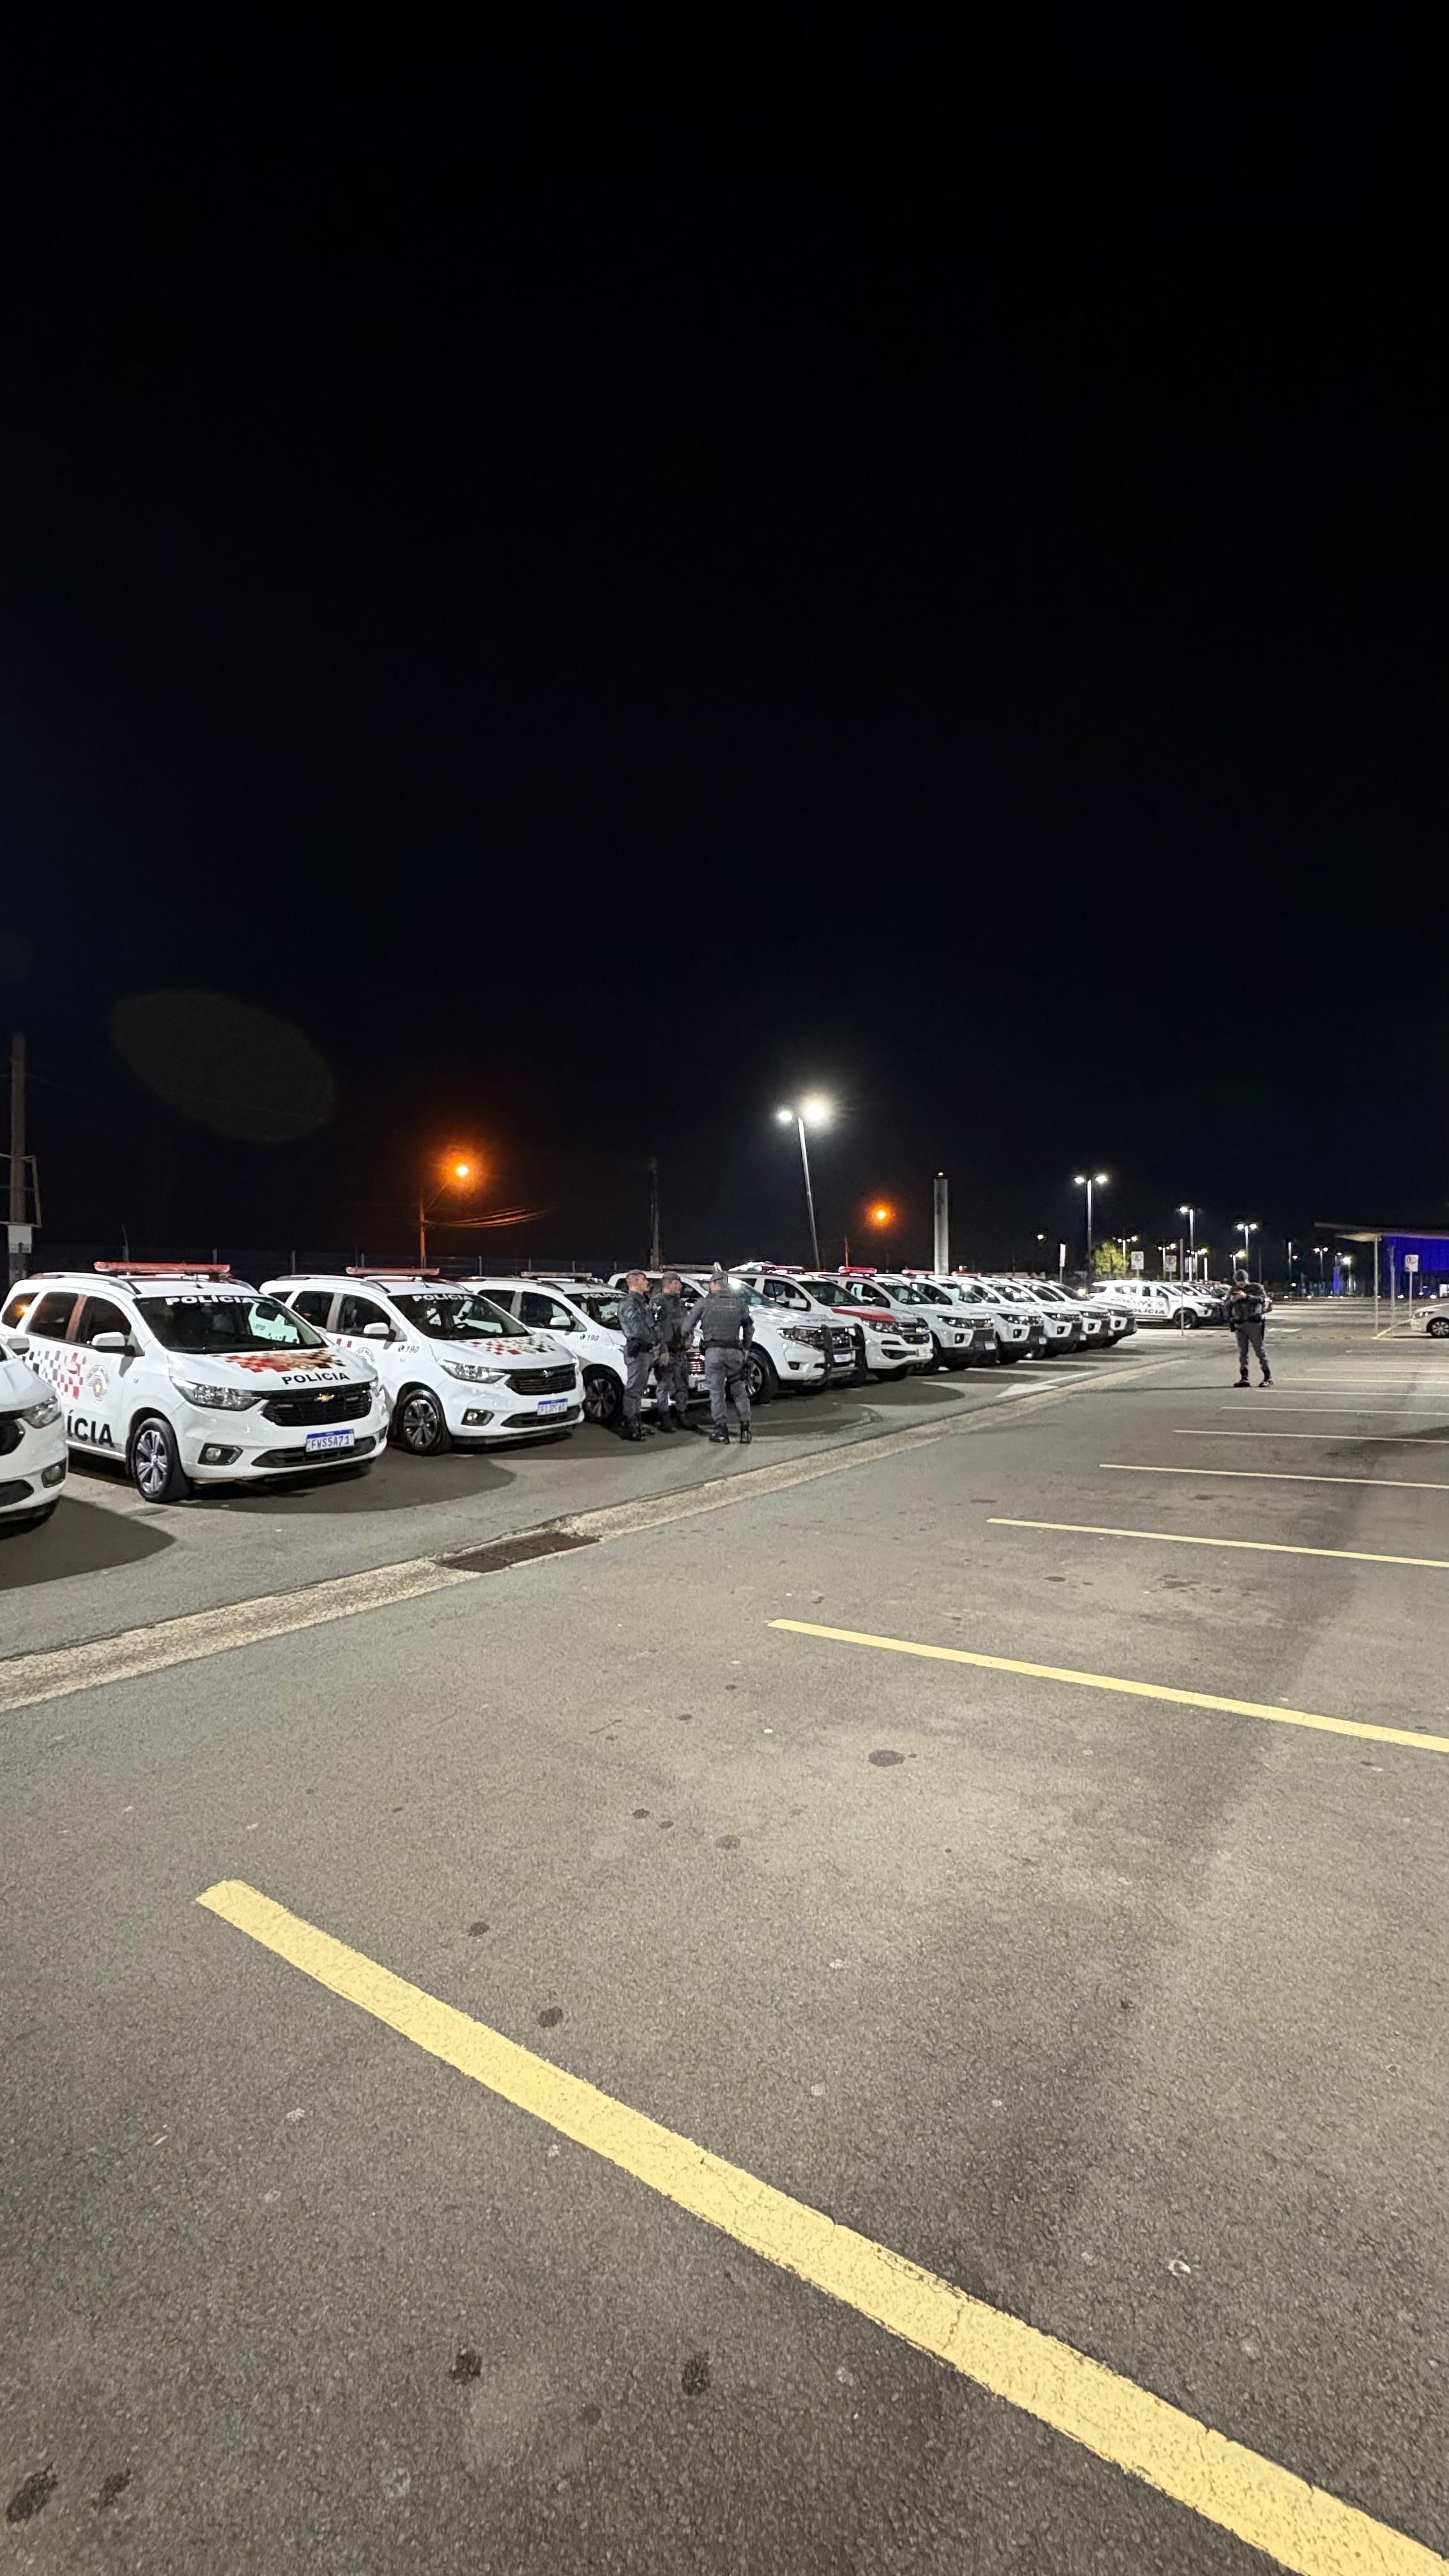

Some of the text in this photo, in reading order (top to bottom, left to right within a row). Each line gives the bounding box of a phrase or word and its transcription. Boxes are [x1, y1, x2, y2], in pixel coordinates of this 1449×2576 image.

[165, 1295, 254, 1305] POLÍCIA
[281, 1372, 351, 1384] POLÍCIA
[67, 1409, 115, 1448] ÍCIA
